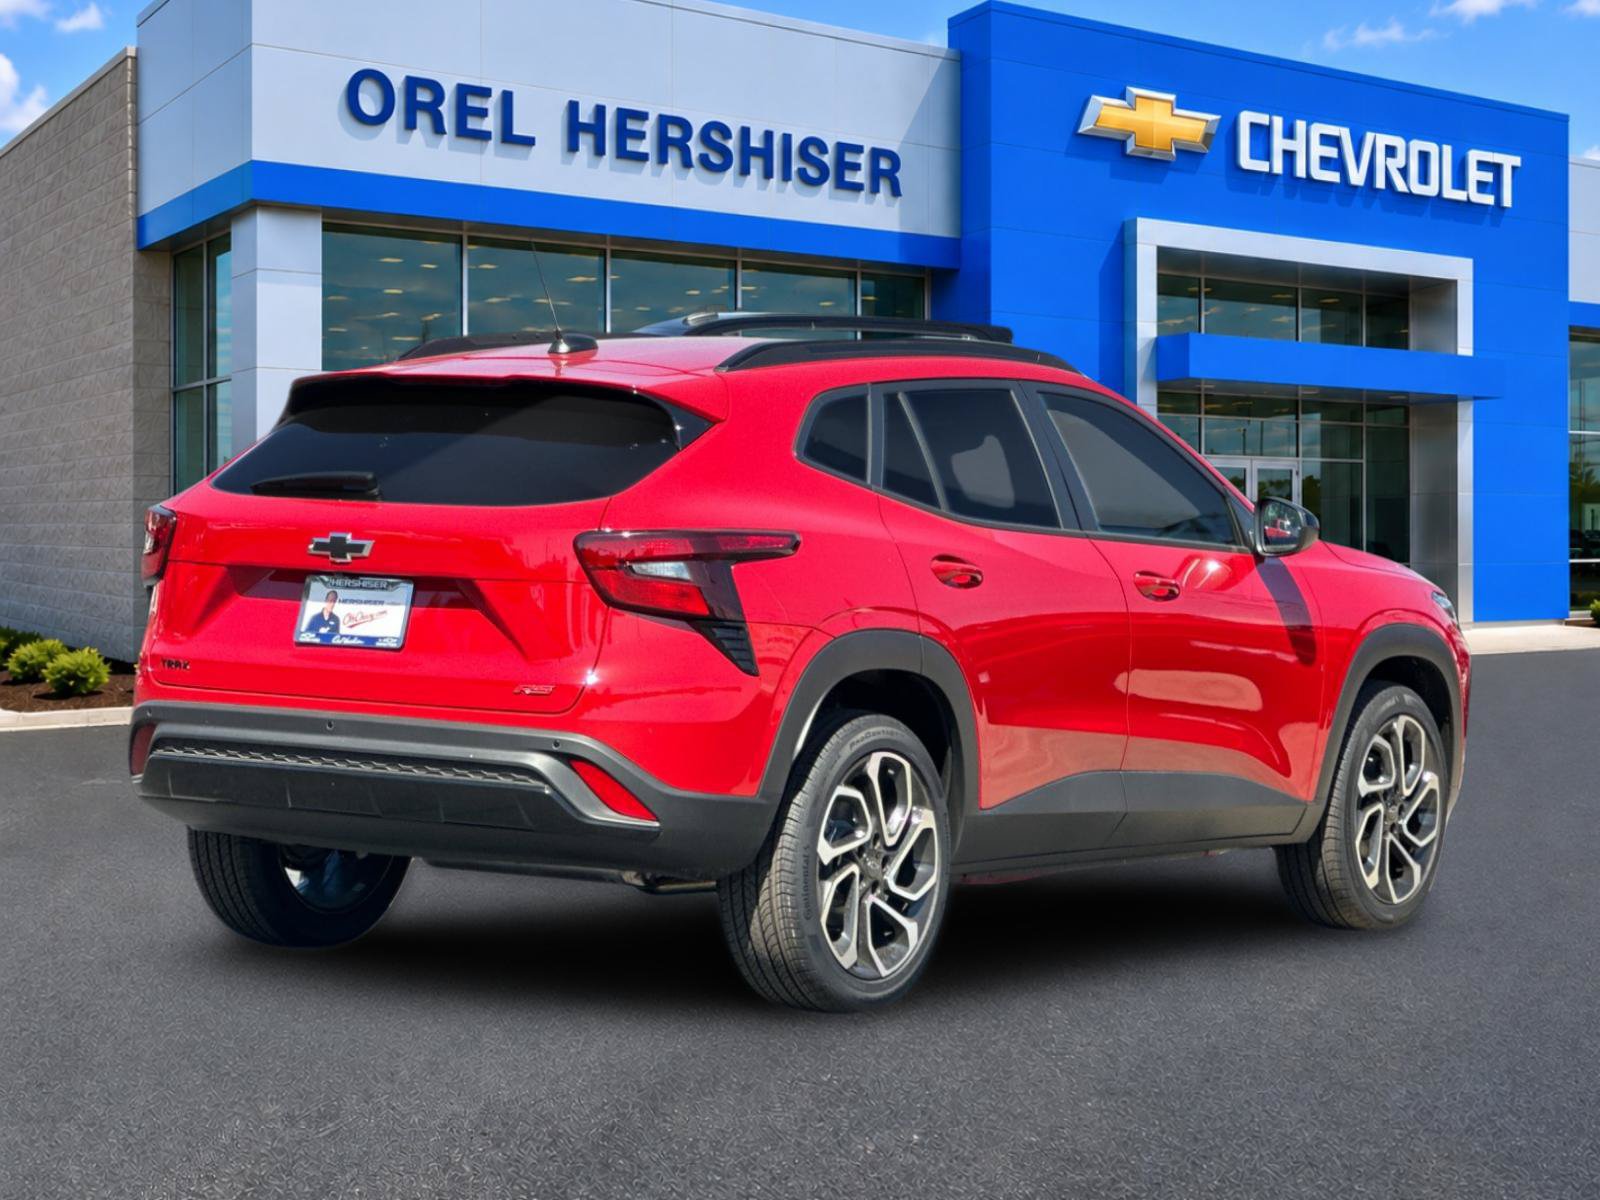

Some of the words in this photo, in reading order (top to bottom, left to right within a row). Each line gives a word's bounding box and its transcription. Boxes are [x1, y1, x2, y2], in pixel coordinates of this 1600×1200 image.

[346, 69, 535, 147] OREL
[566, 100, 902, 197] HERSHISER
[1236, 110, 1521, 208] CHEVROLET
[331, 579, 388, 588] HERSHISER
